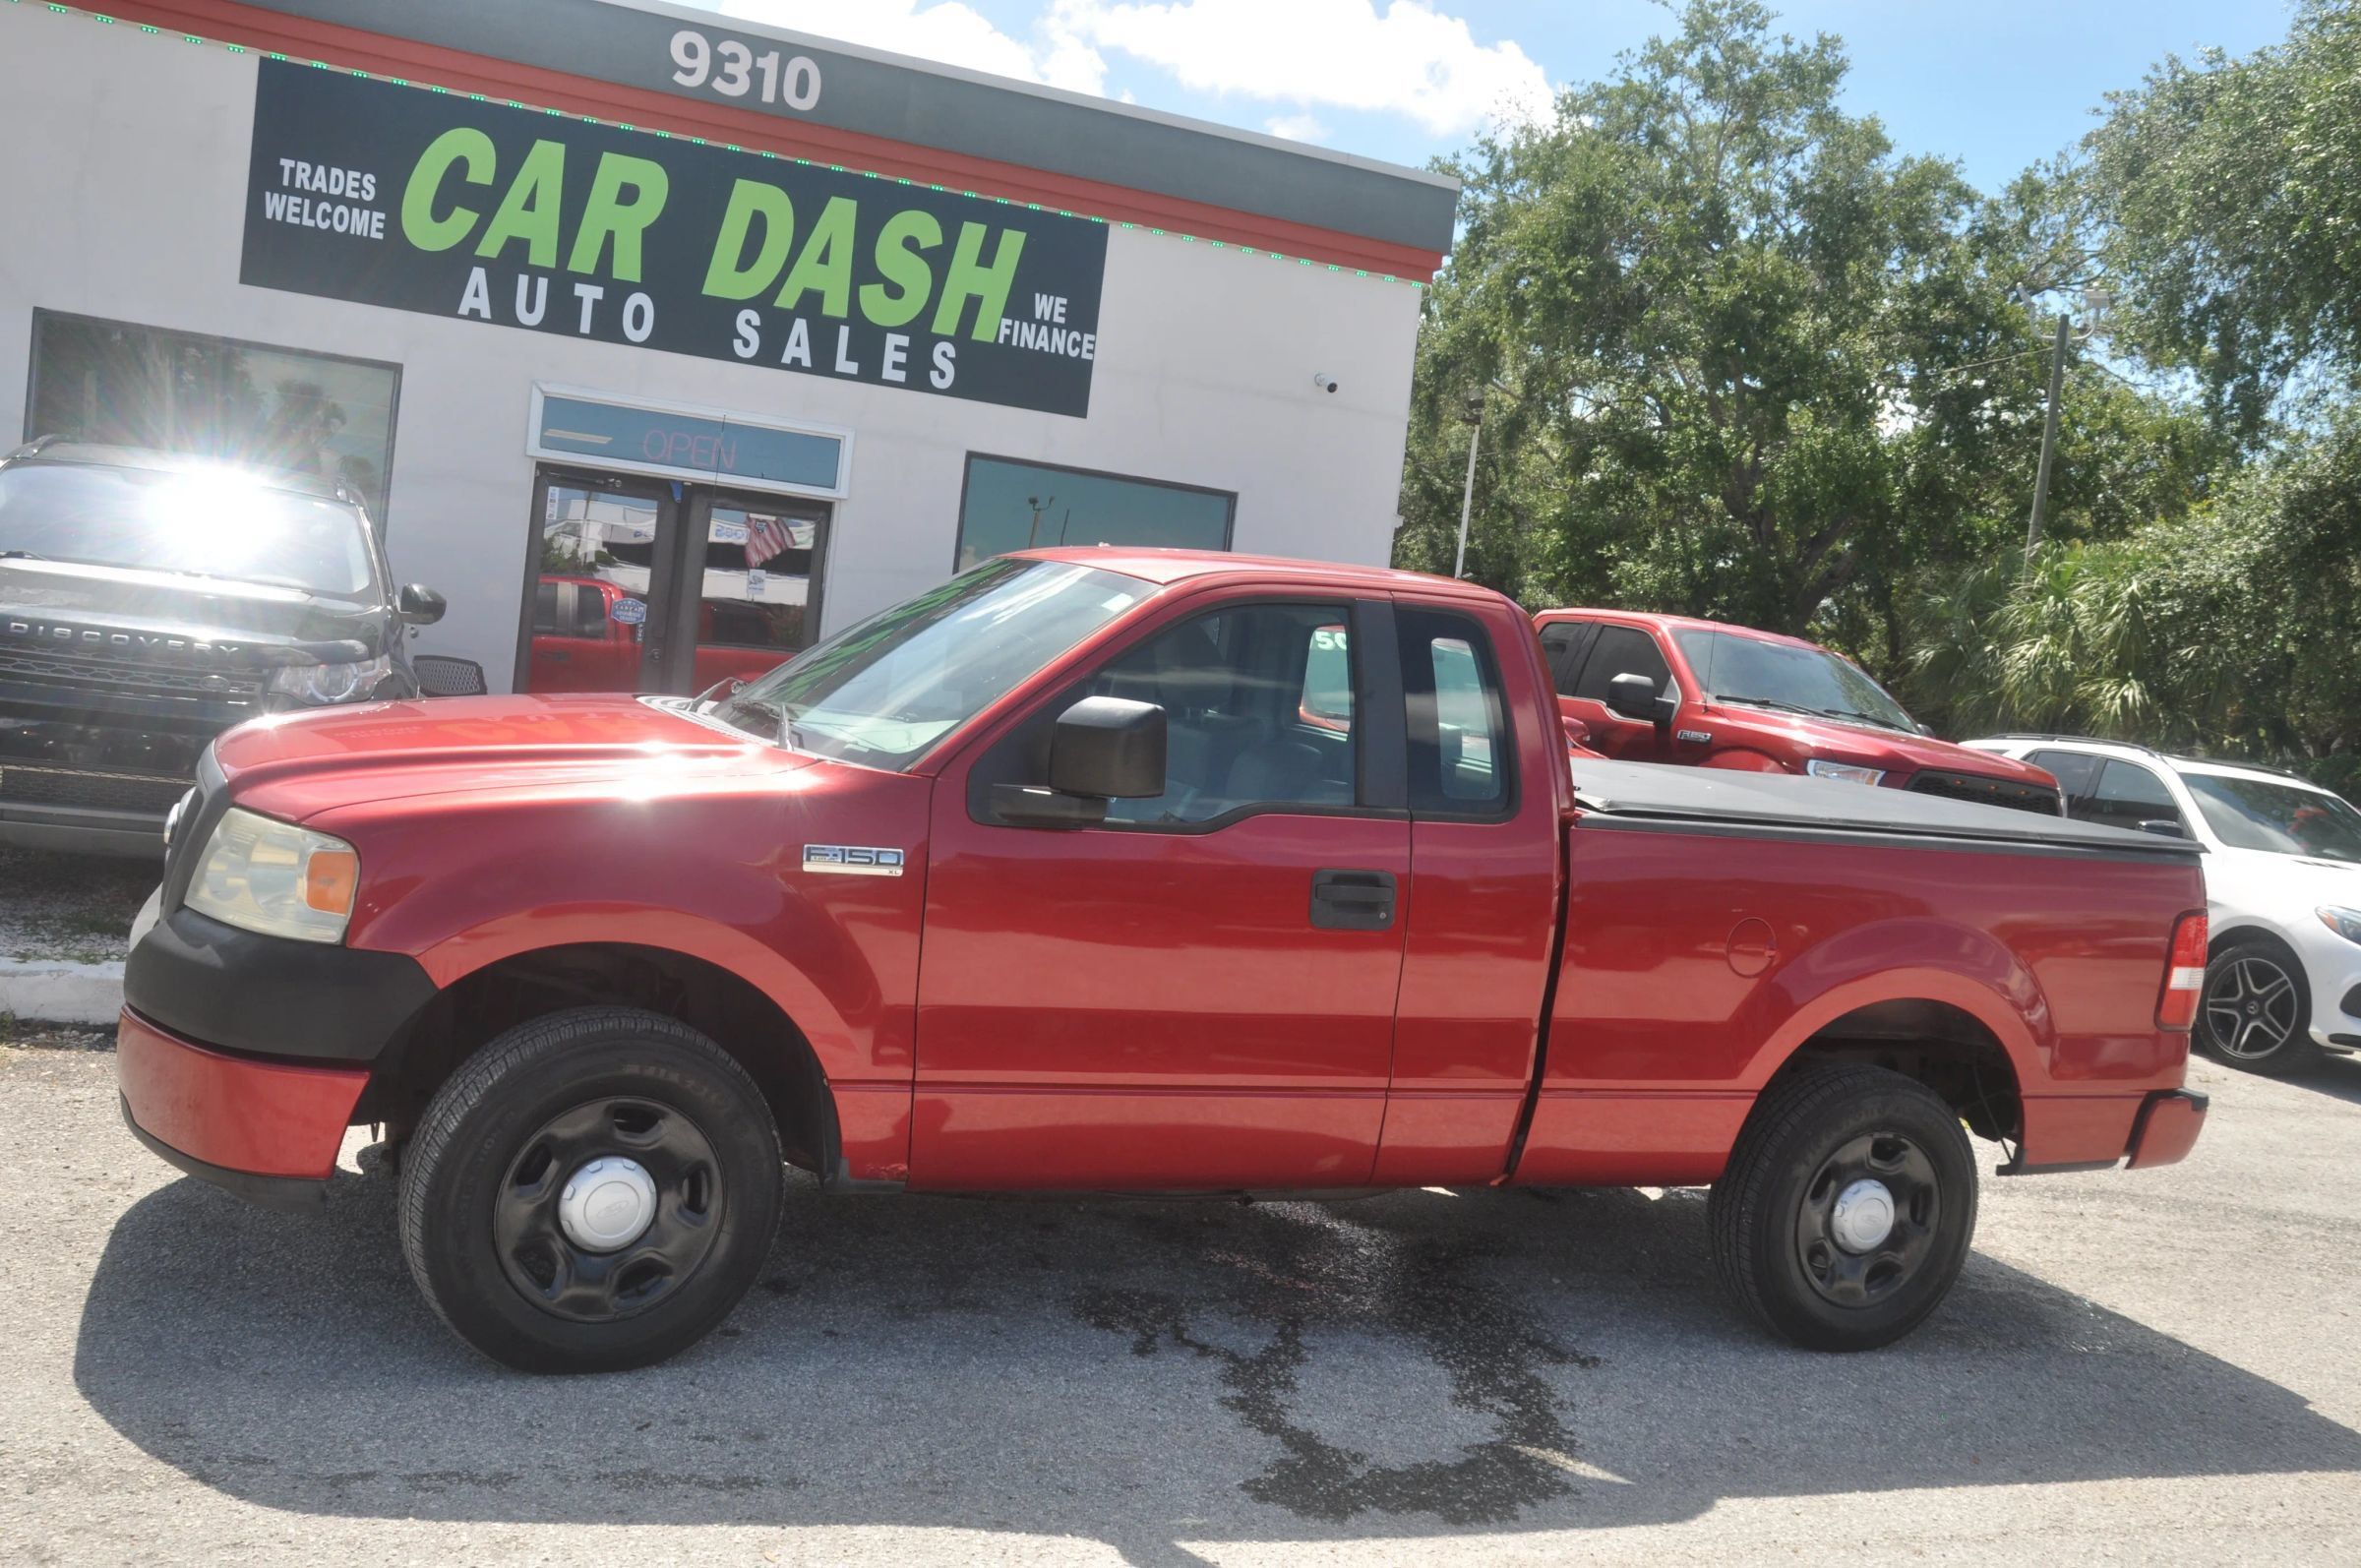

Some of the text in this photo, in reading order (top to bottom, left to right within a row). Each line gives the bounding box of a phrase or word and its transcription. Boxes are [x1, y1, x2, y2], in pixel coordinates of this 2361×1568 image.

[670, 30, 821, 111] 9310
[279, 157, 376, 202] TRADES
[265, 191, 387, 240] WELCOME
[400, 127, 1027, 343] CAR DASH
[457, 266, 956, 390] AUTO SALES
[1034, 292, 1068, 325] WE
[998, 317, 1096, 361] FINANCE
[642, 429, 738, 470] OPEN
[9, 622, 239, 656] DISCOVERY
